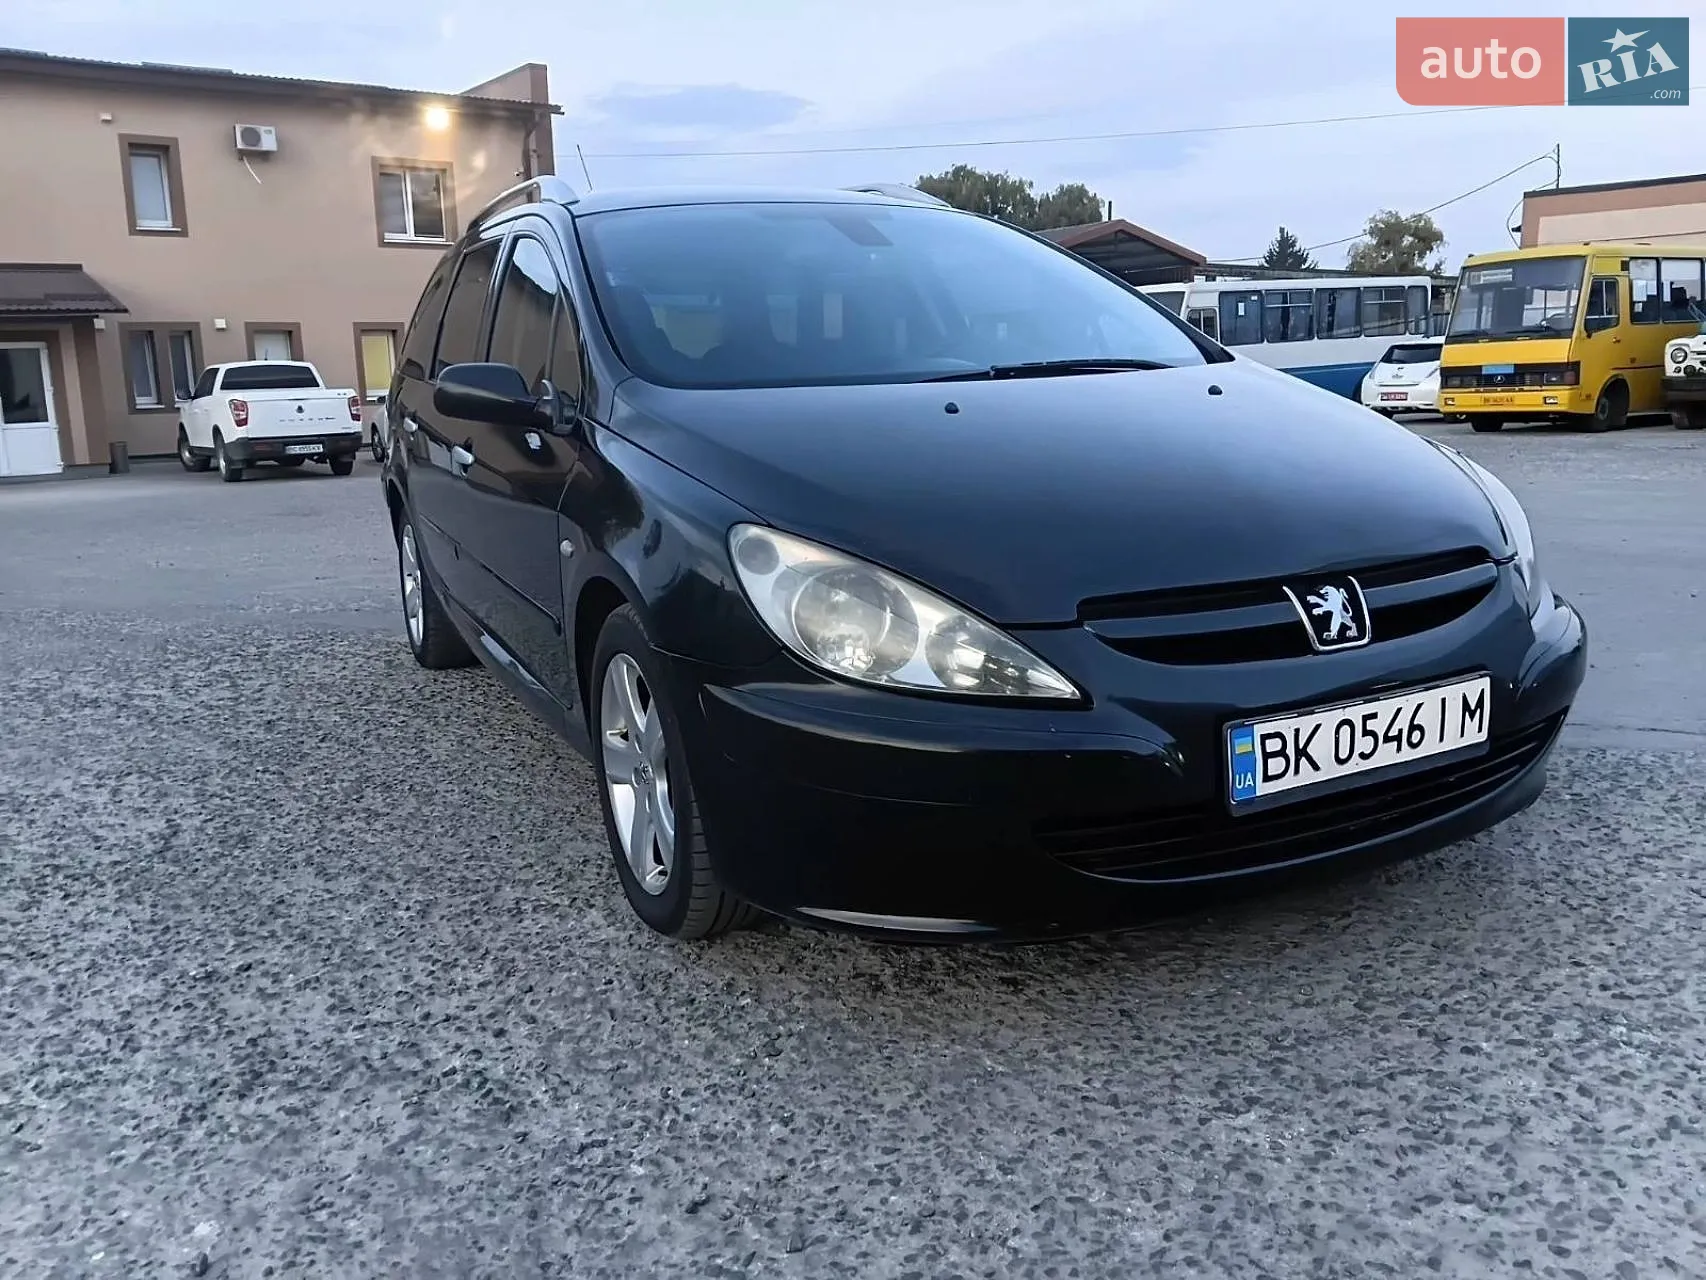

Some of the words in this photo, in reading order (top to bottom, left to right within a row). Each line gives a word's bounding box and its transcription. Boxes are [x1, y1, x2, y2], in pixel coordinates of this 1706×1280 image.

[1259, 722, 1323, 784] BK
[1333, 701, 1426, 766] 0546
[1235, 771, 1255, 790] UA
